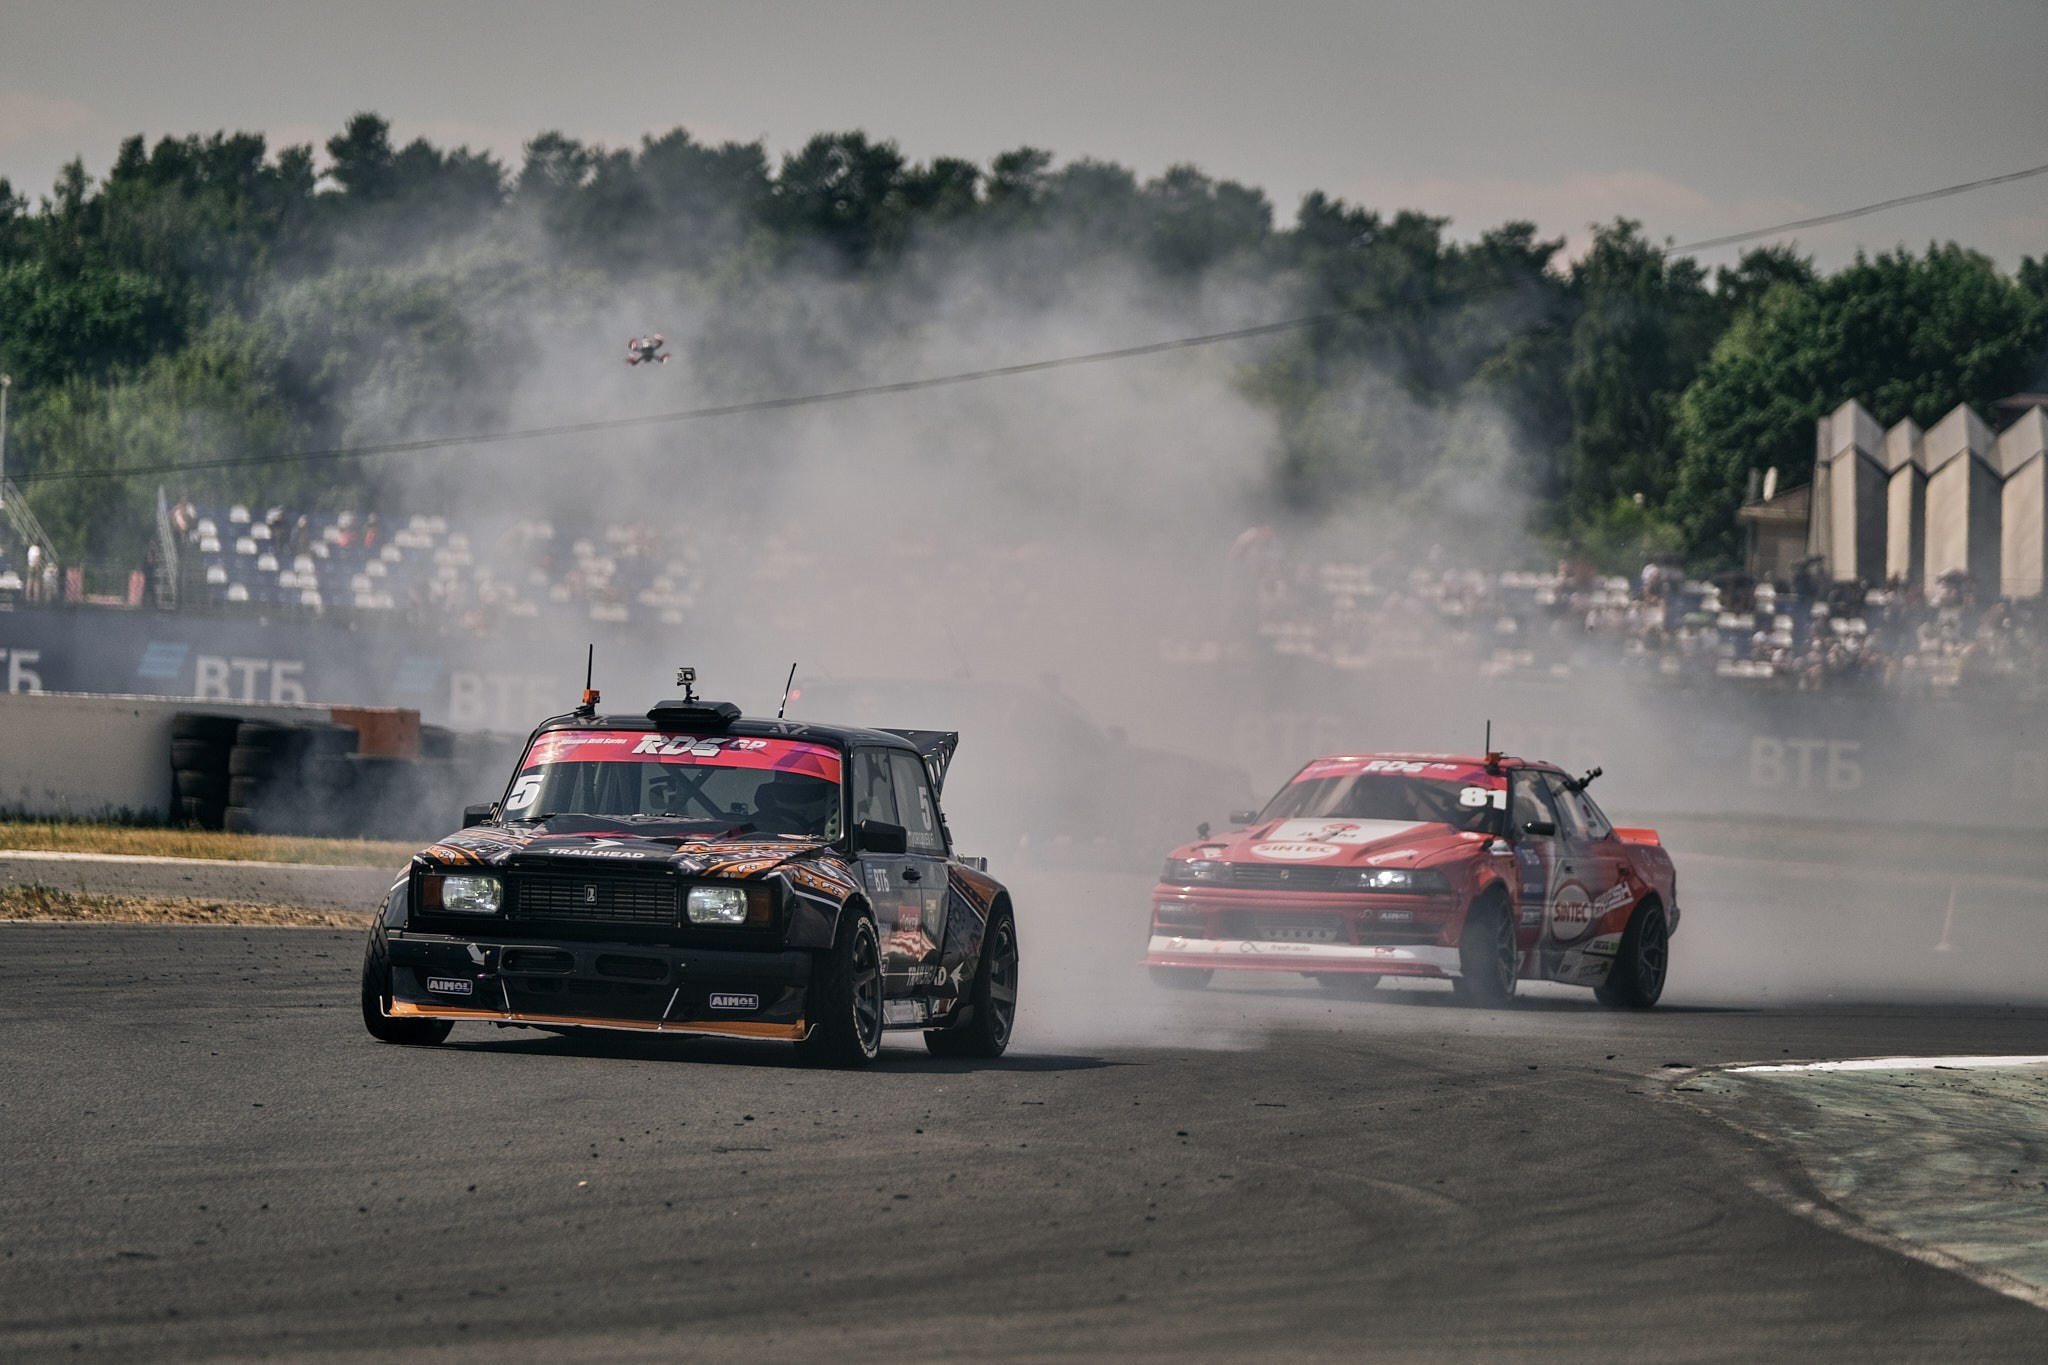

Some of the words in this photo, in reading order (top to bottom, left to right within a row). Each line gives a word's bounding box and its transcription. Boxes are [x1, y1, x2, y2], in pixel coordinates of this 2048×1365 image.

[194, 655, 306, 704] ВТБ
[632, 734, 730, 757] RDS
[1363, 760, 1432, 773] RDS
[1751, 736, 1864, 790] ВТБ
[506, 774, 545, 811] 5
[1459, 787, 1507, 811] 81
[918, 786, 932, 831] 5
[547, 848, 645, 859] TRAILHEAD
[1259, 845, 1332, 854] SINTEC
[873, 868, 890, 893] ВТБ
[1553, 900, 1589, 923] SINTEC
[429, 980, 471, 993] AIMOL
[711, 996, 758, 1008] AIMOL
